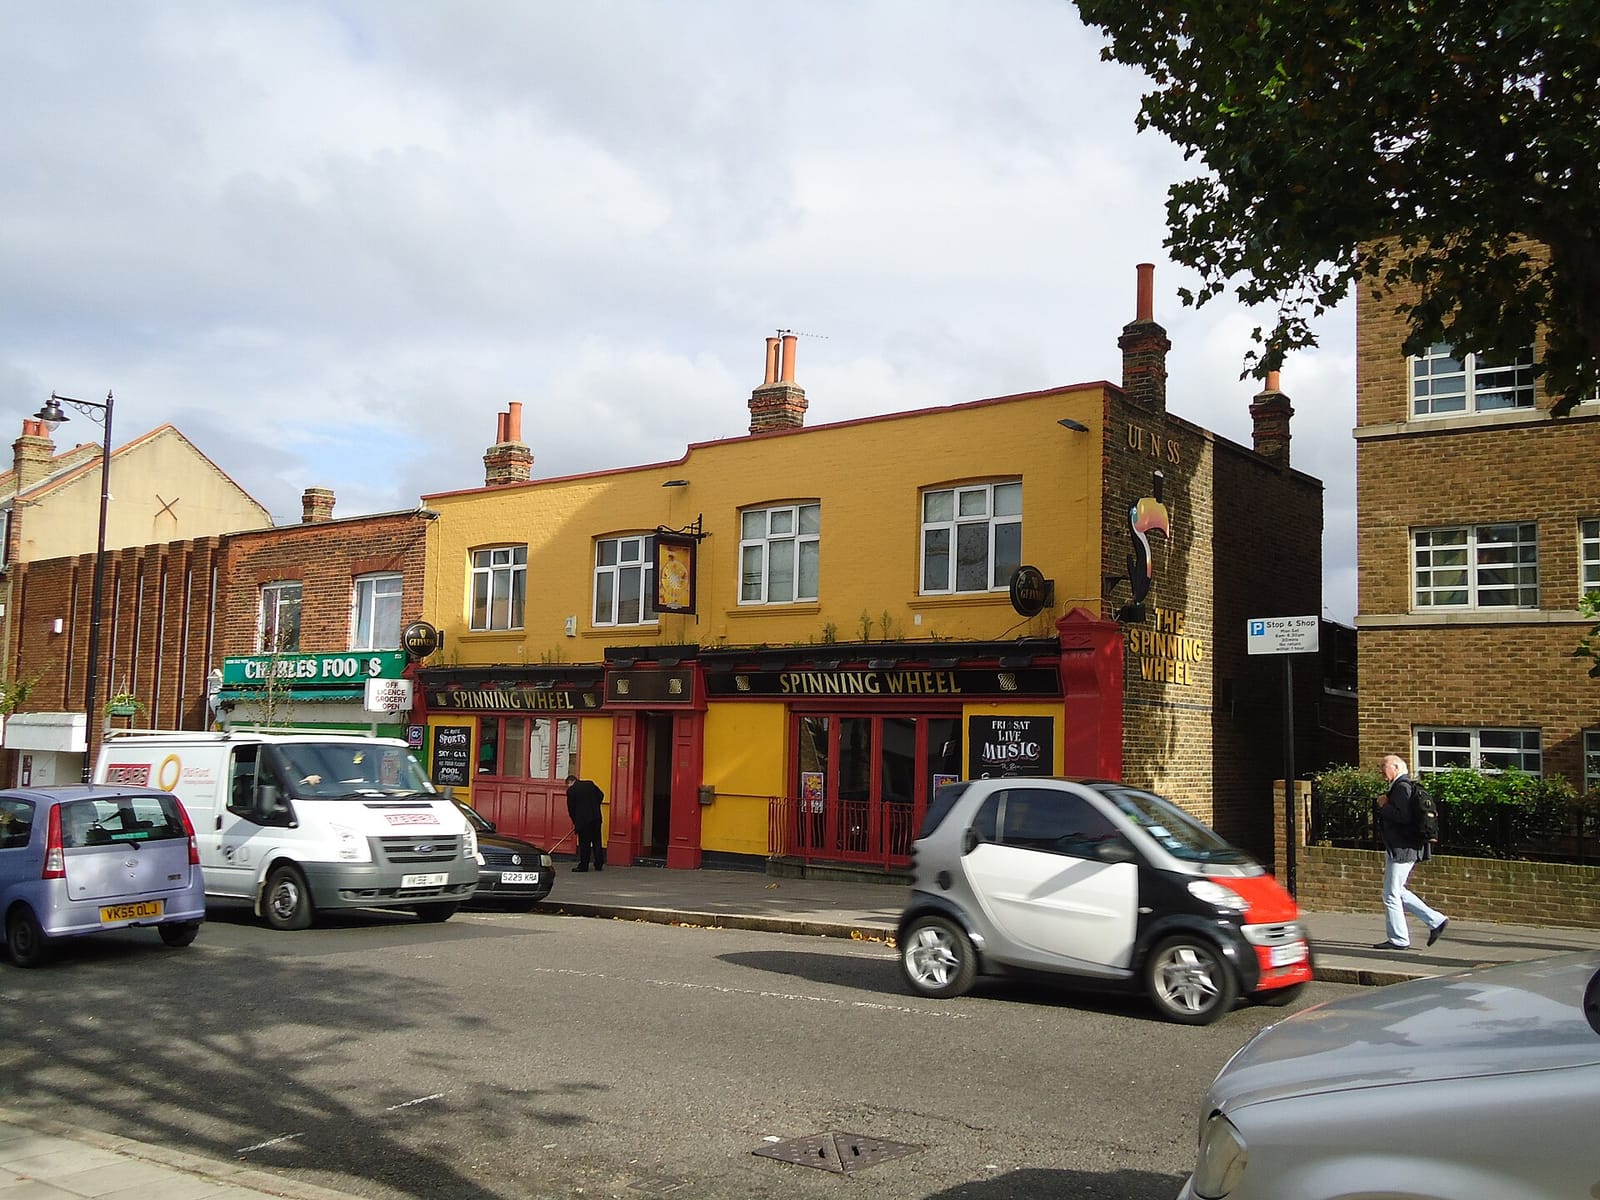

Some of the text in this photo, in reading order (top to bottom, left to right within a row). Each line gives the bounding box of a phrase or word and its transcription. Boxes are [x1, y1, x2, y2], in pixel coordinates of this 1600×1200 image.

[1155, 607, 1185, 634] THE
[1266, 621, 1284, 629] Stop
[1130, 628, 1203, 661] SPINNING
[245, 659, 318, 679] CHRLES
[1140, 656, 1193, 685] WHEEL
[780, 671, 961, 694] SPINNING WHEEL
[452, 691, 574, 709] SPINNING WHEEL
[992, 720, 1006, 729] FRI
[1013, 720, 1031, 730] SAT
[439, 733, 467, 745] SPORTS
[998, 730, 1021, 742] LIVE
[981, 741, 1038, 760] MUSIC
[502, 872, 537, 881] S229 KRA
[106, 903, 158, 919] VK55 OLJ
